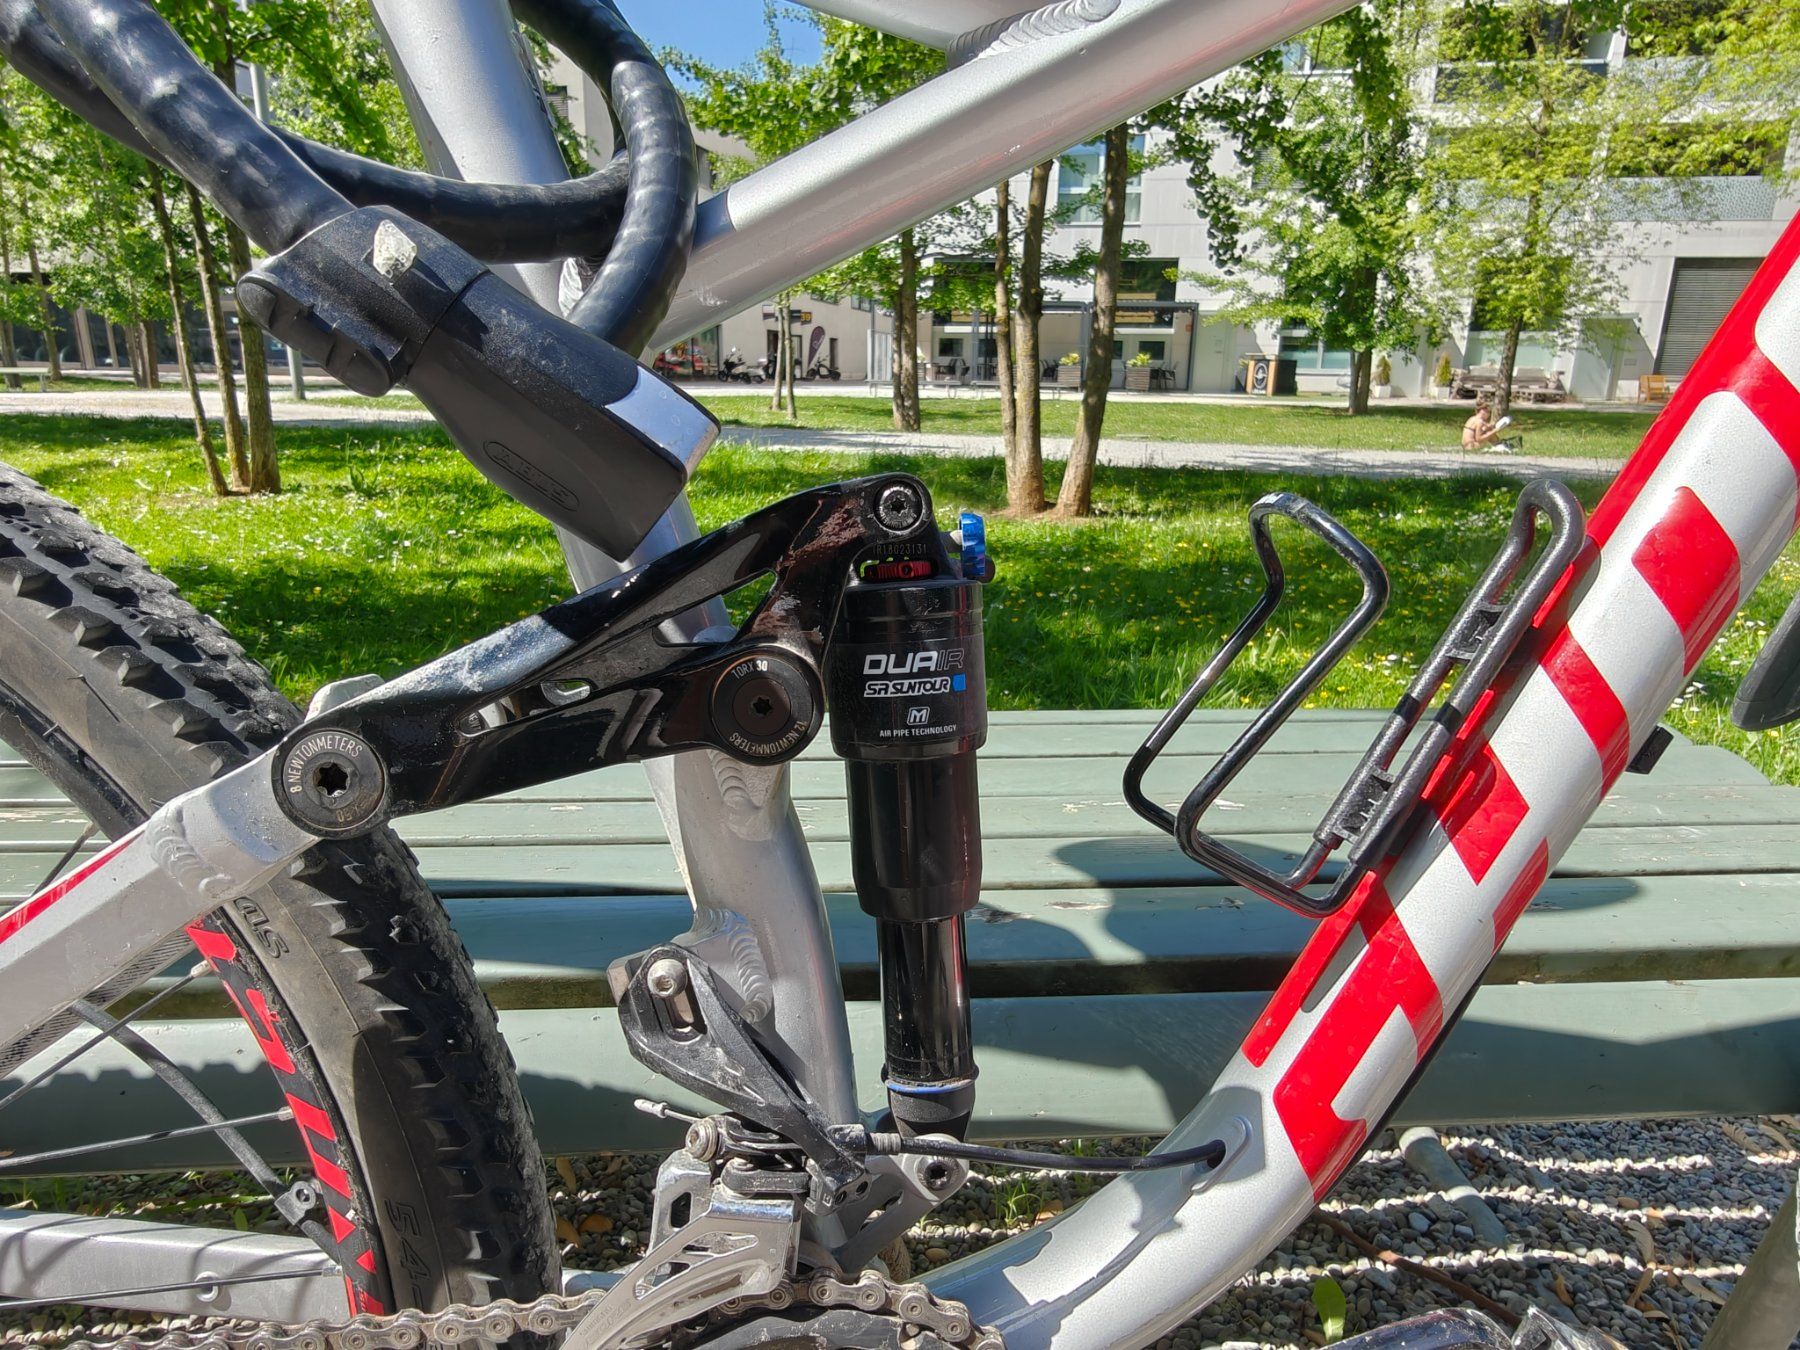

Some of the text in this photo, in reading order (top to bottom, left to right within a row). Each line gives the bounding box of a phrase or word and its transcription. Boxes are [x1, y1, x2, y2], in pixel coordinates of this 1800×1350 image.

[730, 659, 769, 679] TORX 30
[890, 676, 951, 695] SUNTOUR
[879, 724, 957, 738] AIR PIPE TECHNOLOGY
[729, 730, 800, 755] NEWTONMETERS
[287, 735, 363, 783] NEWTONMETERS
[289, 785, 303, 794] 8
